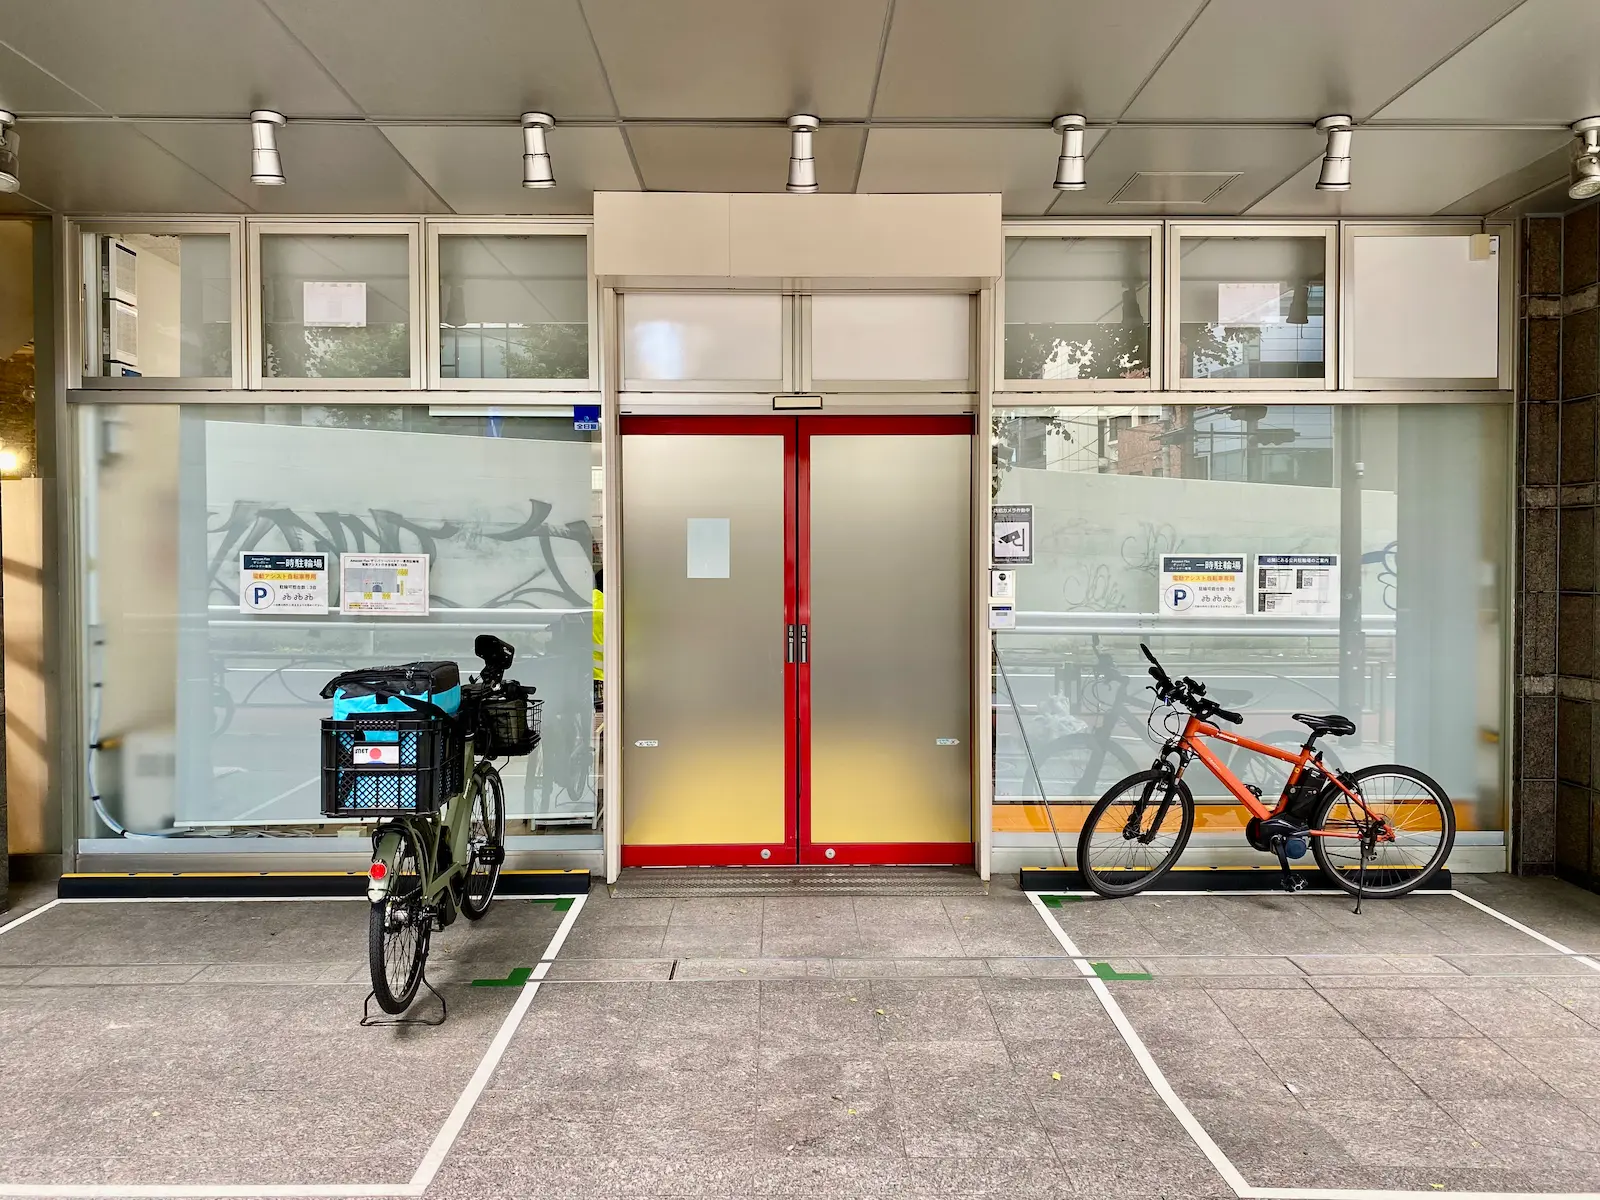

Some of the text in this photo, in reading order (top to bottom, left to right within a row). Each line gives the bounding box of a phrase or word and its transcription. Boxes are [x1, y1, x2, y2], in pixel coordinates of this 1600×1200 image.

[276, 558, 323, 569] 一時駐輪場
[1195, 560, 1241, 570] 一時駐輪場
[254, 587, 268, 605] P
[1173, 589, 1187, 606] P
